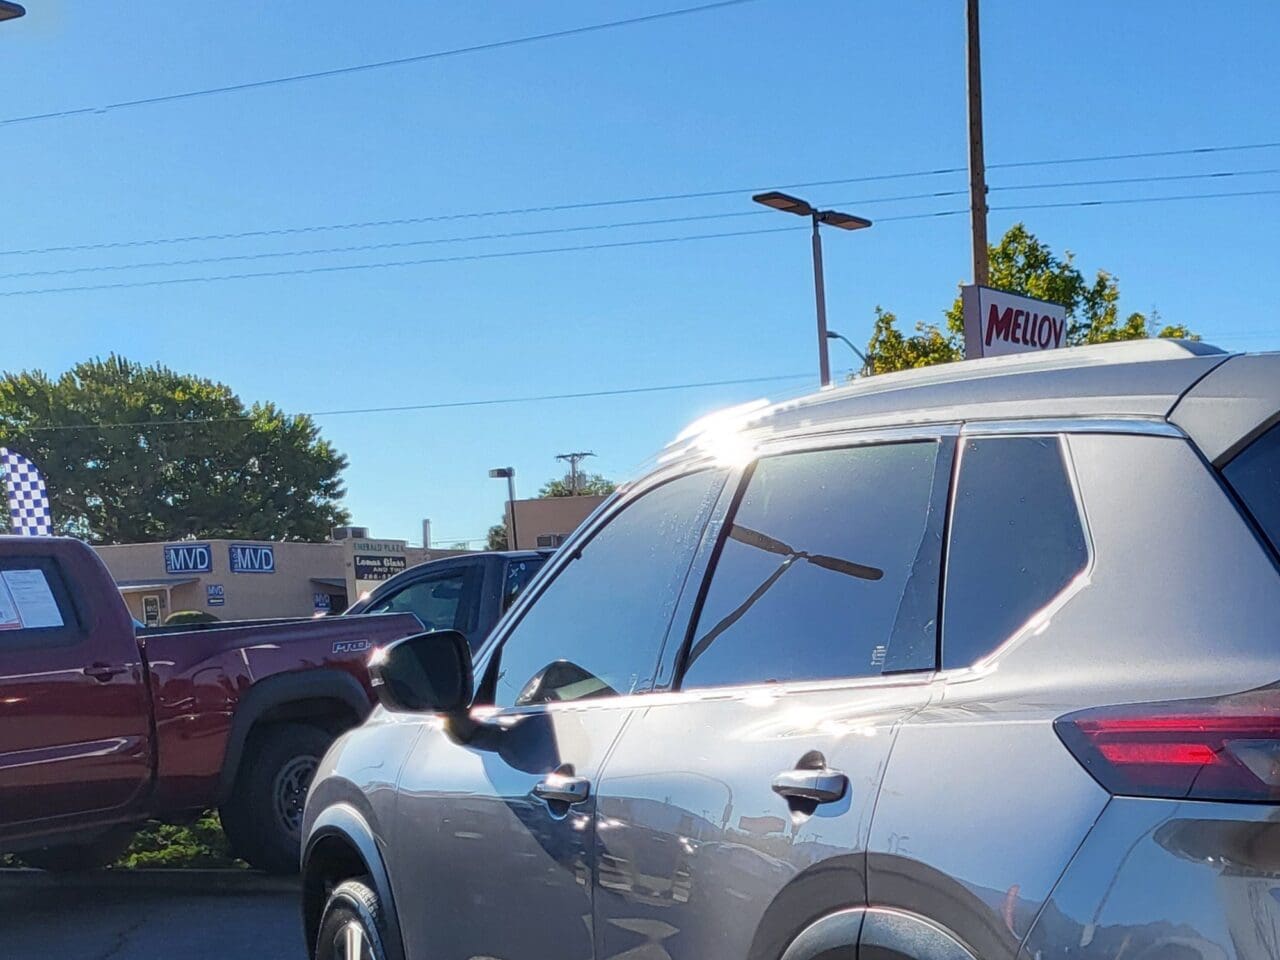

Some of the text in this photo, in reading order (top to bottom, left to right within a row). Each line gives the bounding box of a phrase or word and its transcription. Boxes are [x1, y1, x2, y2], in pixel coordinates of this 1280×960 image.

[985, 304, 1064, 349] MELLOY
[170, 548, 209, 570] MVD
[238, 548, 274, 570] MVD
[384, 558, 405, 568] Glass
[208, 586, 224, 595] MVD
